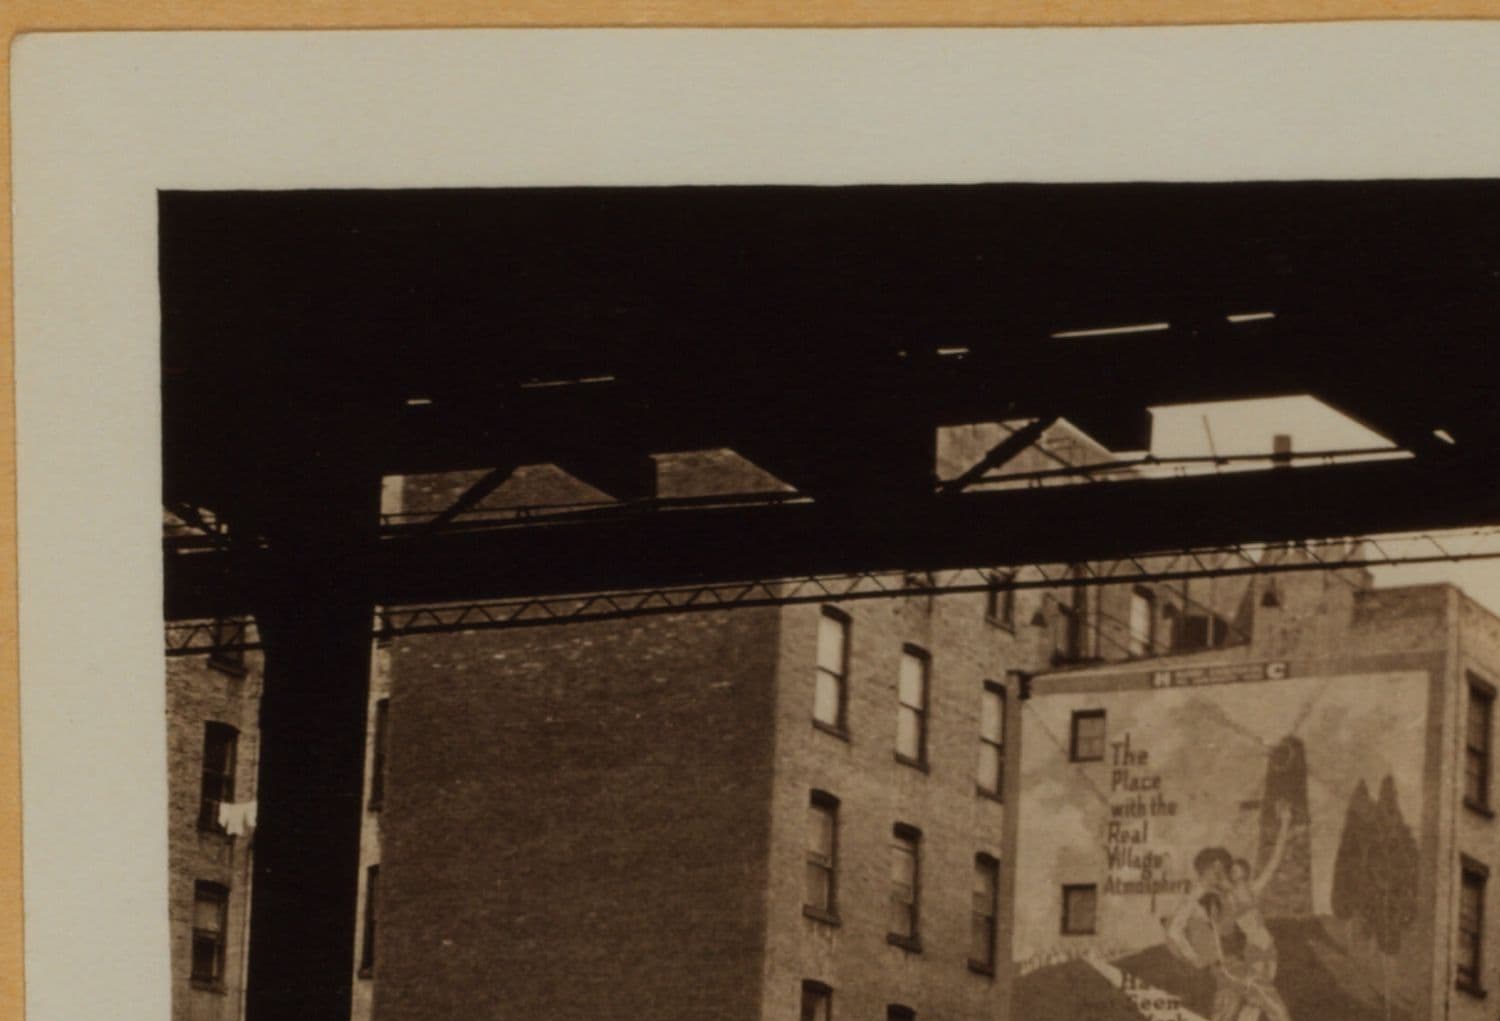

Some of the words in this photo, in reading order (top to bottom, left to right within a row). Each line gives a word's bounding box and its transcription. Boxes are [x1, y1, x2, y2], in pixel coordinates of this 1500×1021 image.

[1111, 732, 1149, 767] The
[1111, 769, 1162, 792] Place
[1110, 793, 1147, 818] with
[1150, 791, 1178, 817] the
[1108, 819, 1149, 844] Real
[1104, 844, 1163, 880] Village
